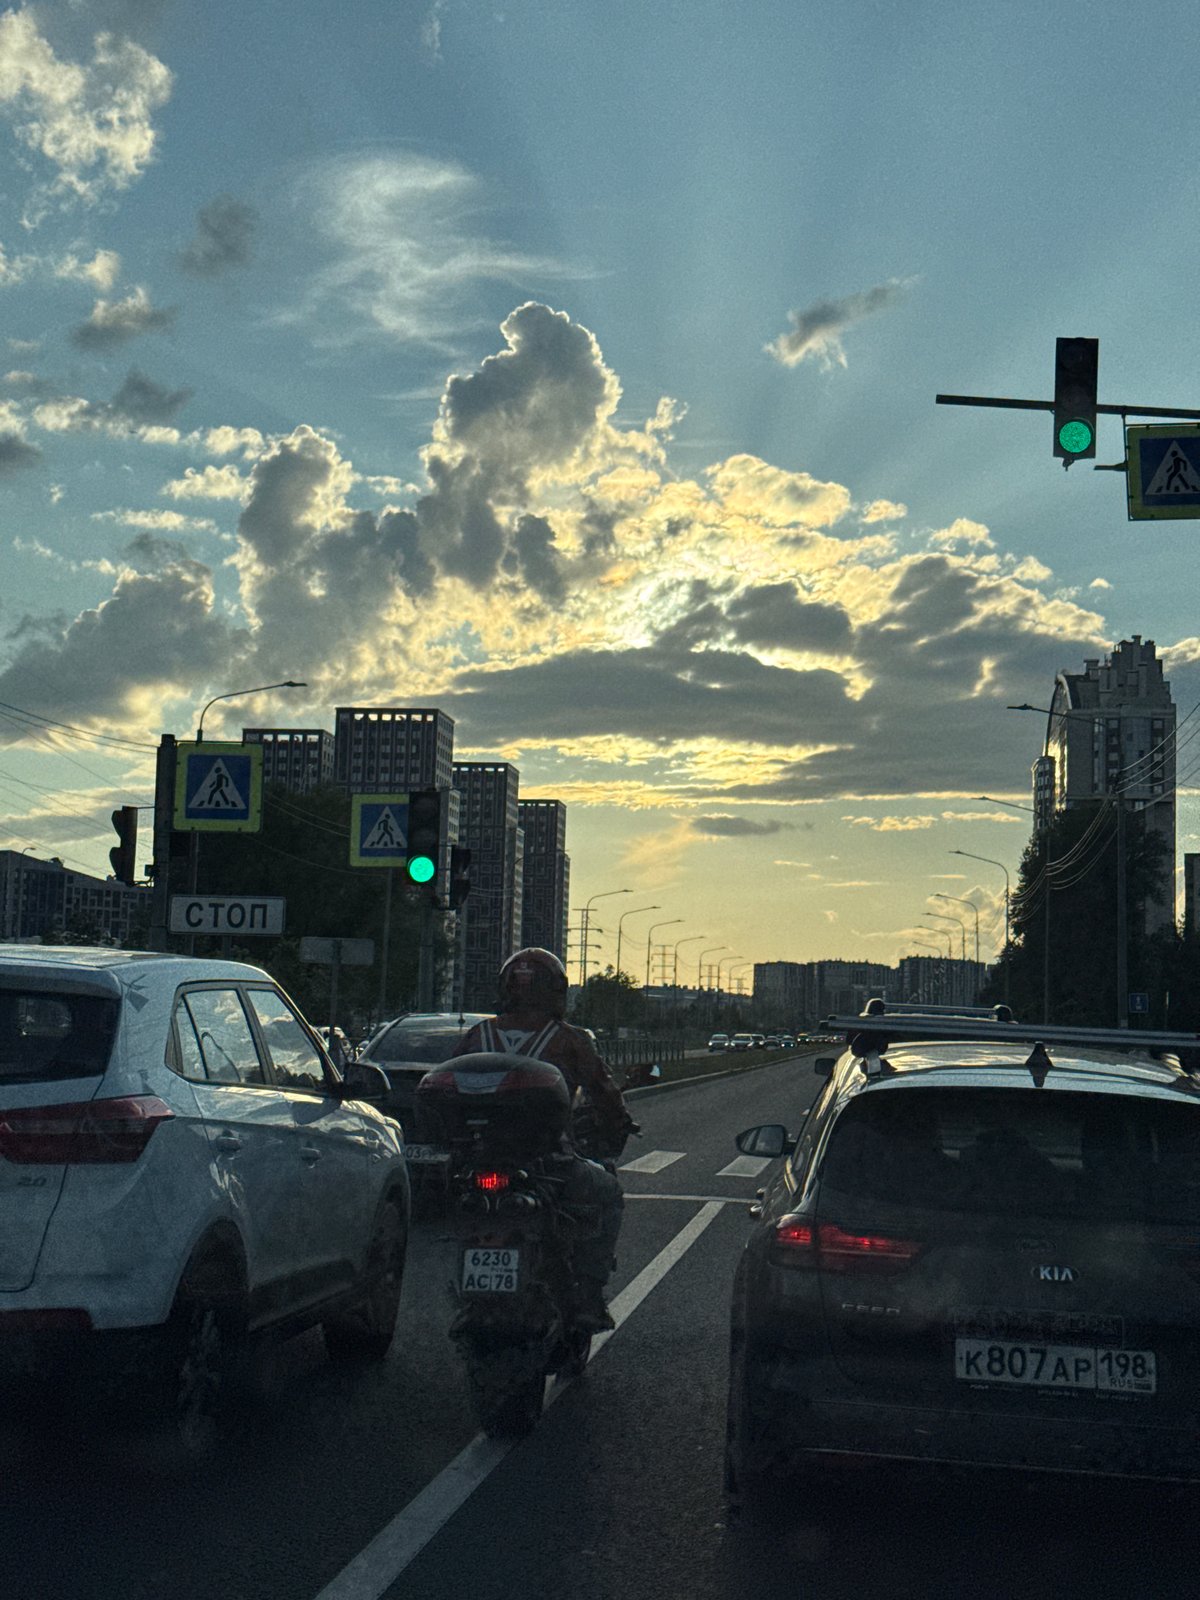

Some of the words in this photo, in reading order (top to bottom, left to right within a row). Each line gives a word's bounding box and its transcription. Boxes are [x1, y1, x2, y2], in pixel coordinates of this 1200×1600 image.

[186, 902, 268, 929] СТОП
[471, 1251, 511, 1266] 6230
[1040, 1265, 1074, 1281] KIA
[495, 1274, 513, 1290] 78
[1100, 1352, 1146, 1379] 198
